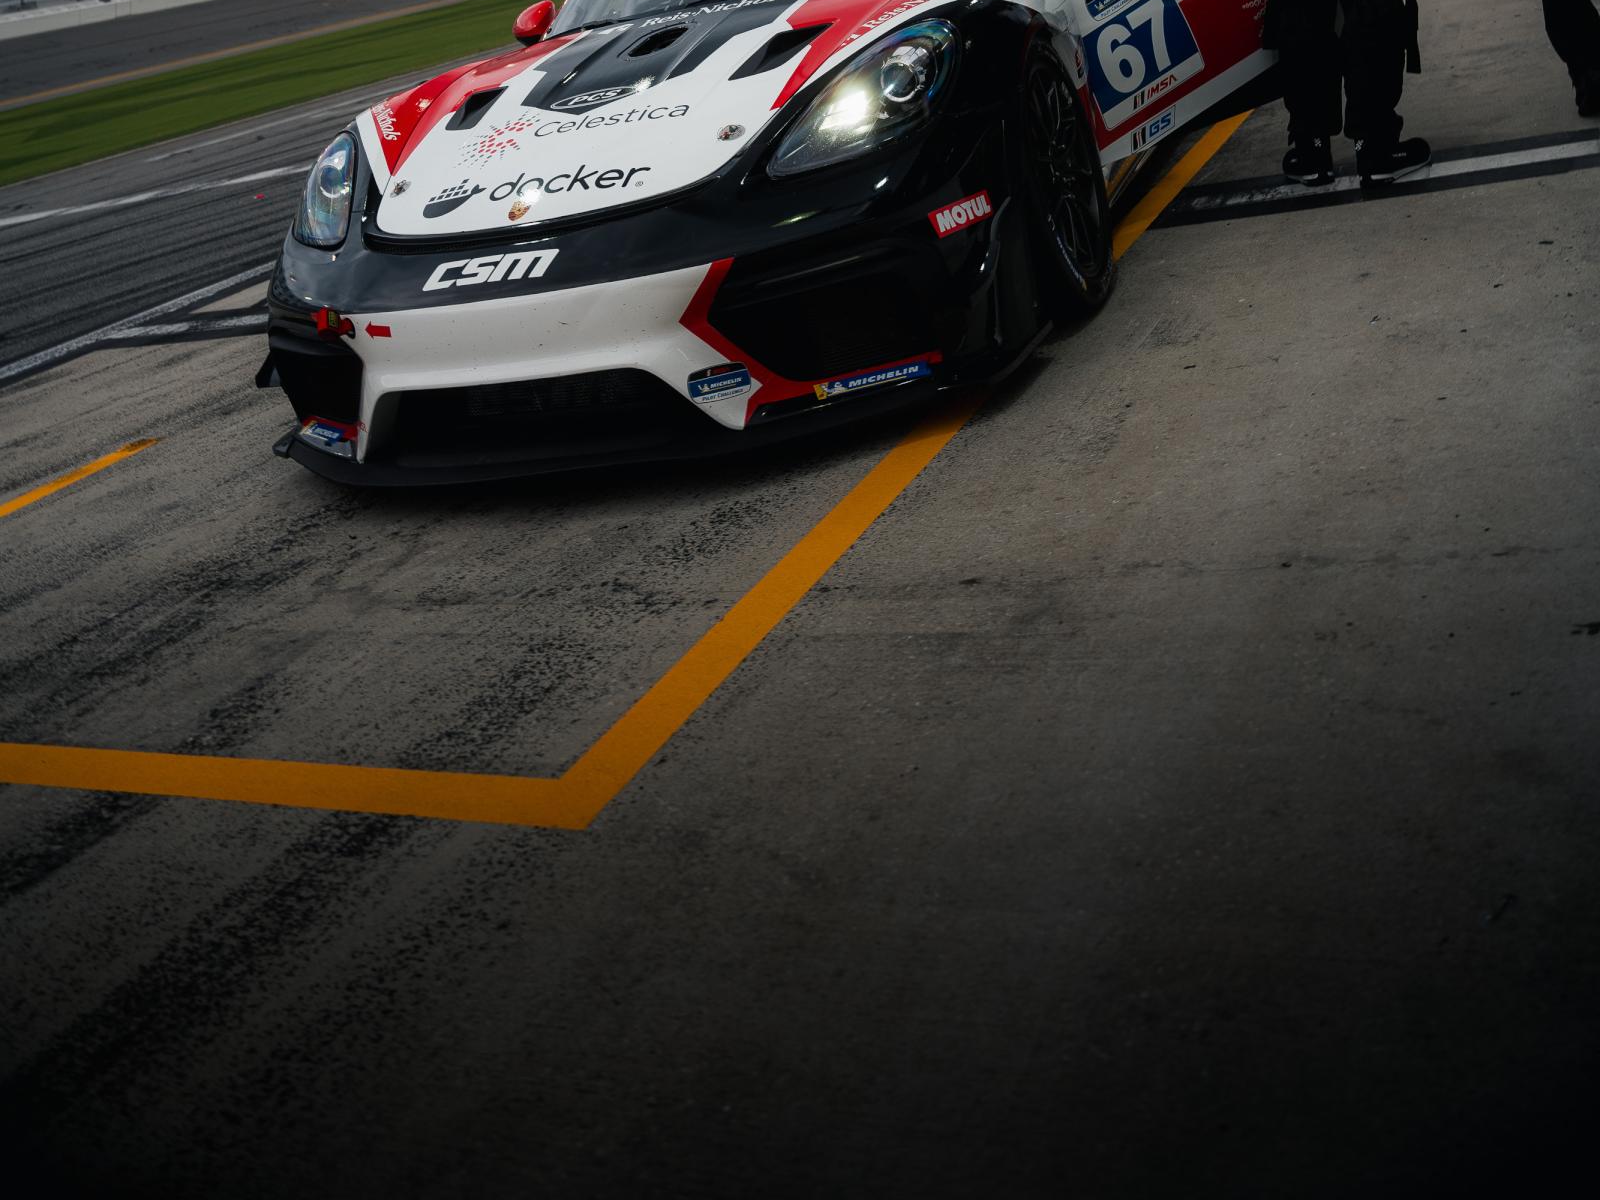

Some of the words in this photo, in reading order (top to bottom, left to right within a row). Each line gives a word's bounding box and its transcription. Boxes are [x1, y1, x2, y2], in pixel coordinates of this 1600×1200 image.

[1147, 74, 1177, 100] IMSA
[1149, 112, 1171, 138] GS
[489, 164, 652, 202] docker
[936, 194, 991, 233] MOTUL
[422, 248, 560, 292] CSM
[709, 377, 742, 389] MICHELIN
[848, 365, 919, 389] MICHELIN
